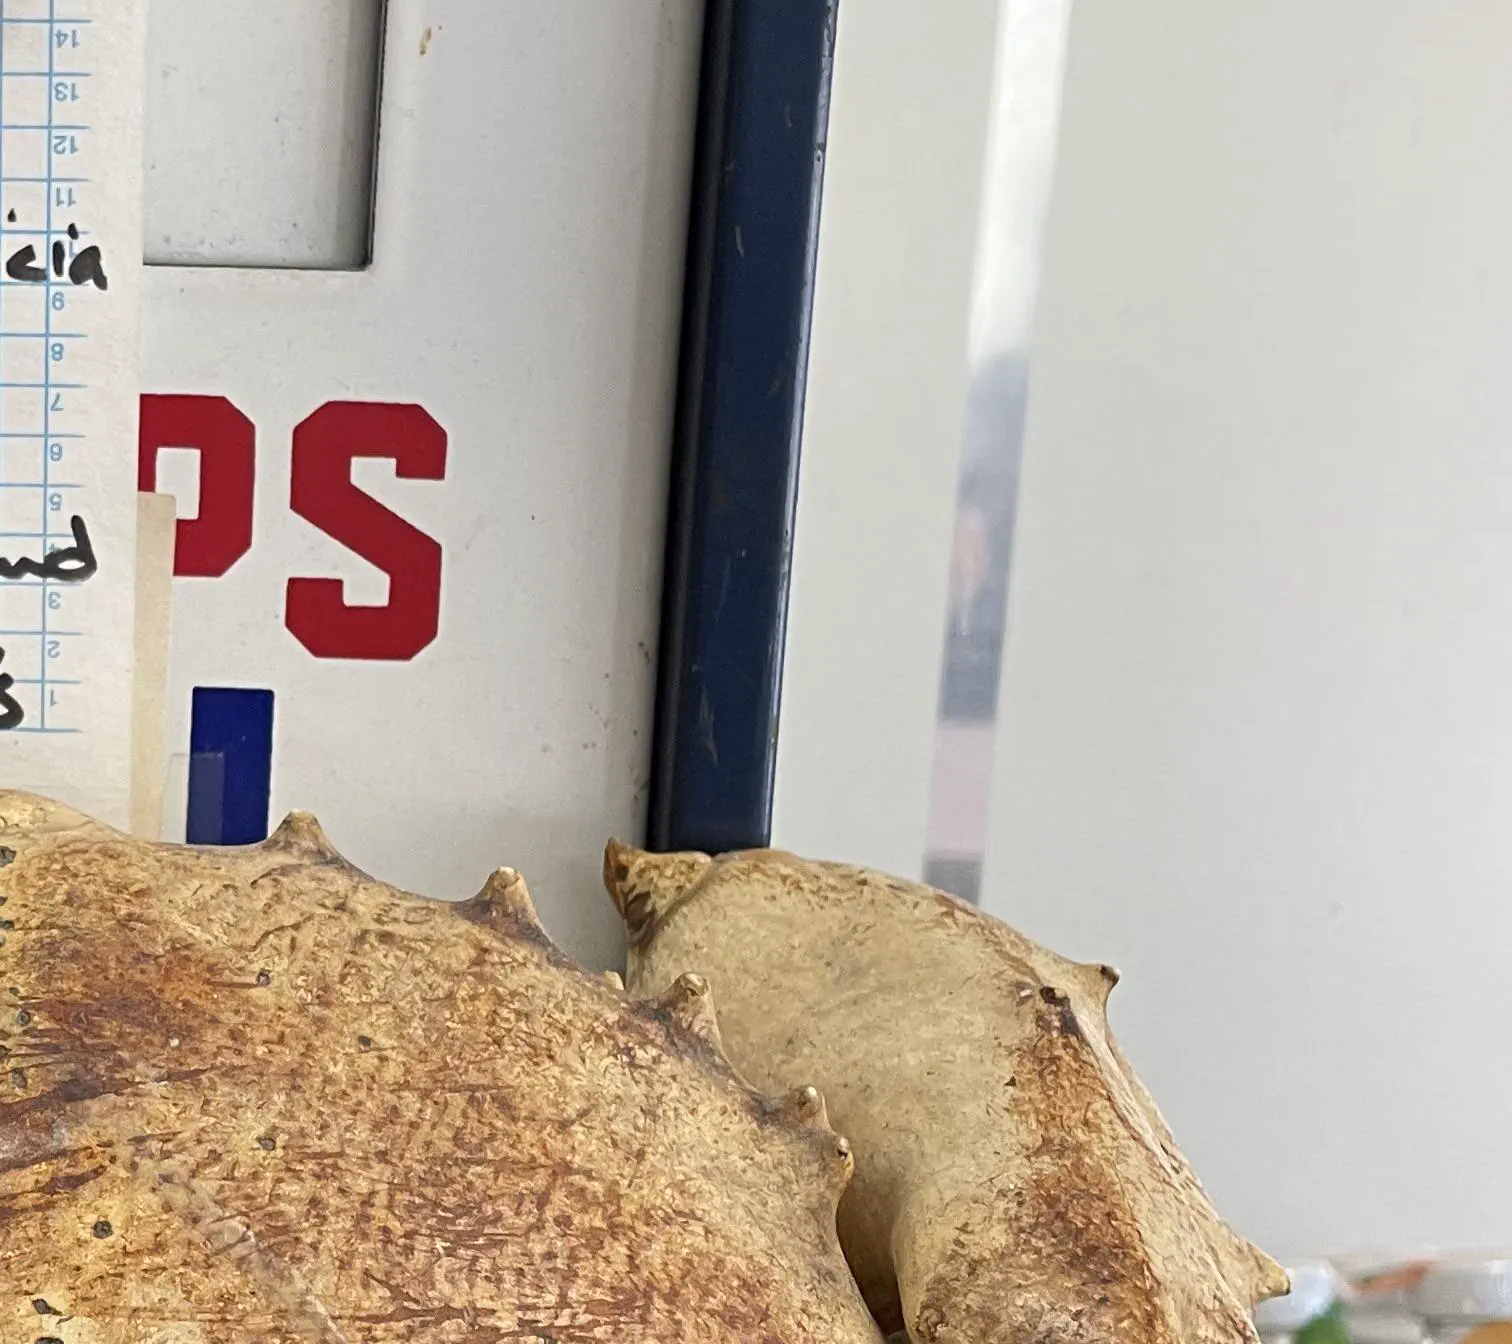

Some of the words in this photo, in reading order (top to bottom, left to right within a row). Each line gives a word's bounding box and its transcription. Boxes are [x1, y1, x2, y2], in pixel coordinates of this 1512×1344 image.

[55, 28, 79, 49] 14
[53, 134, 79, 154] 12
[55, 187, 77, 207] 11
[51, 342, 65, 362] 8
